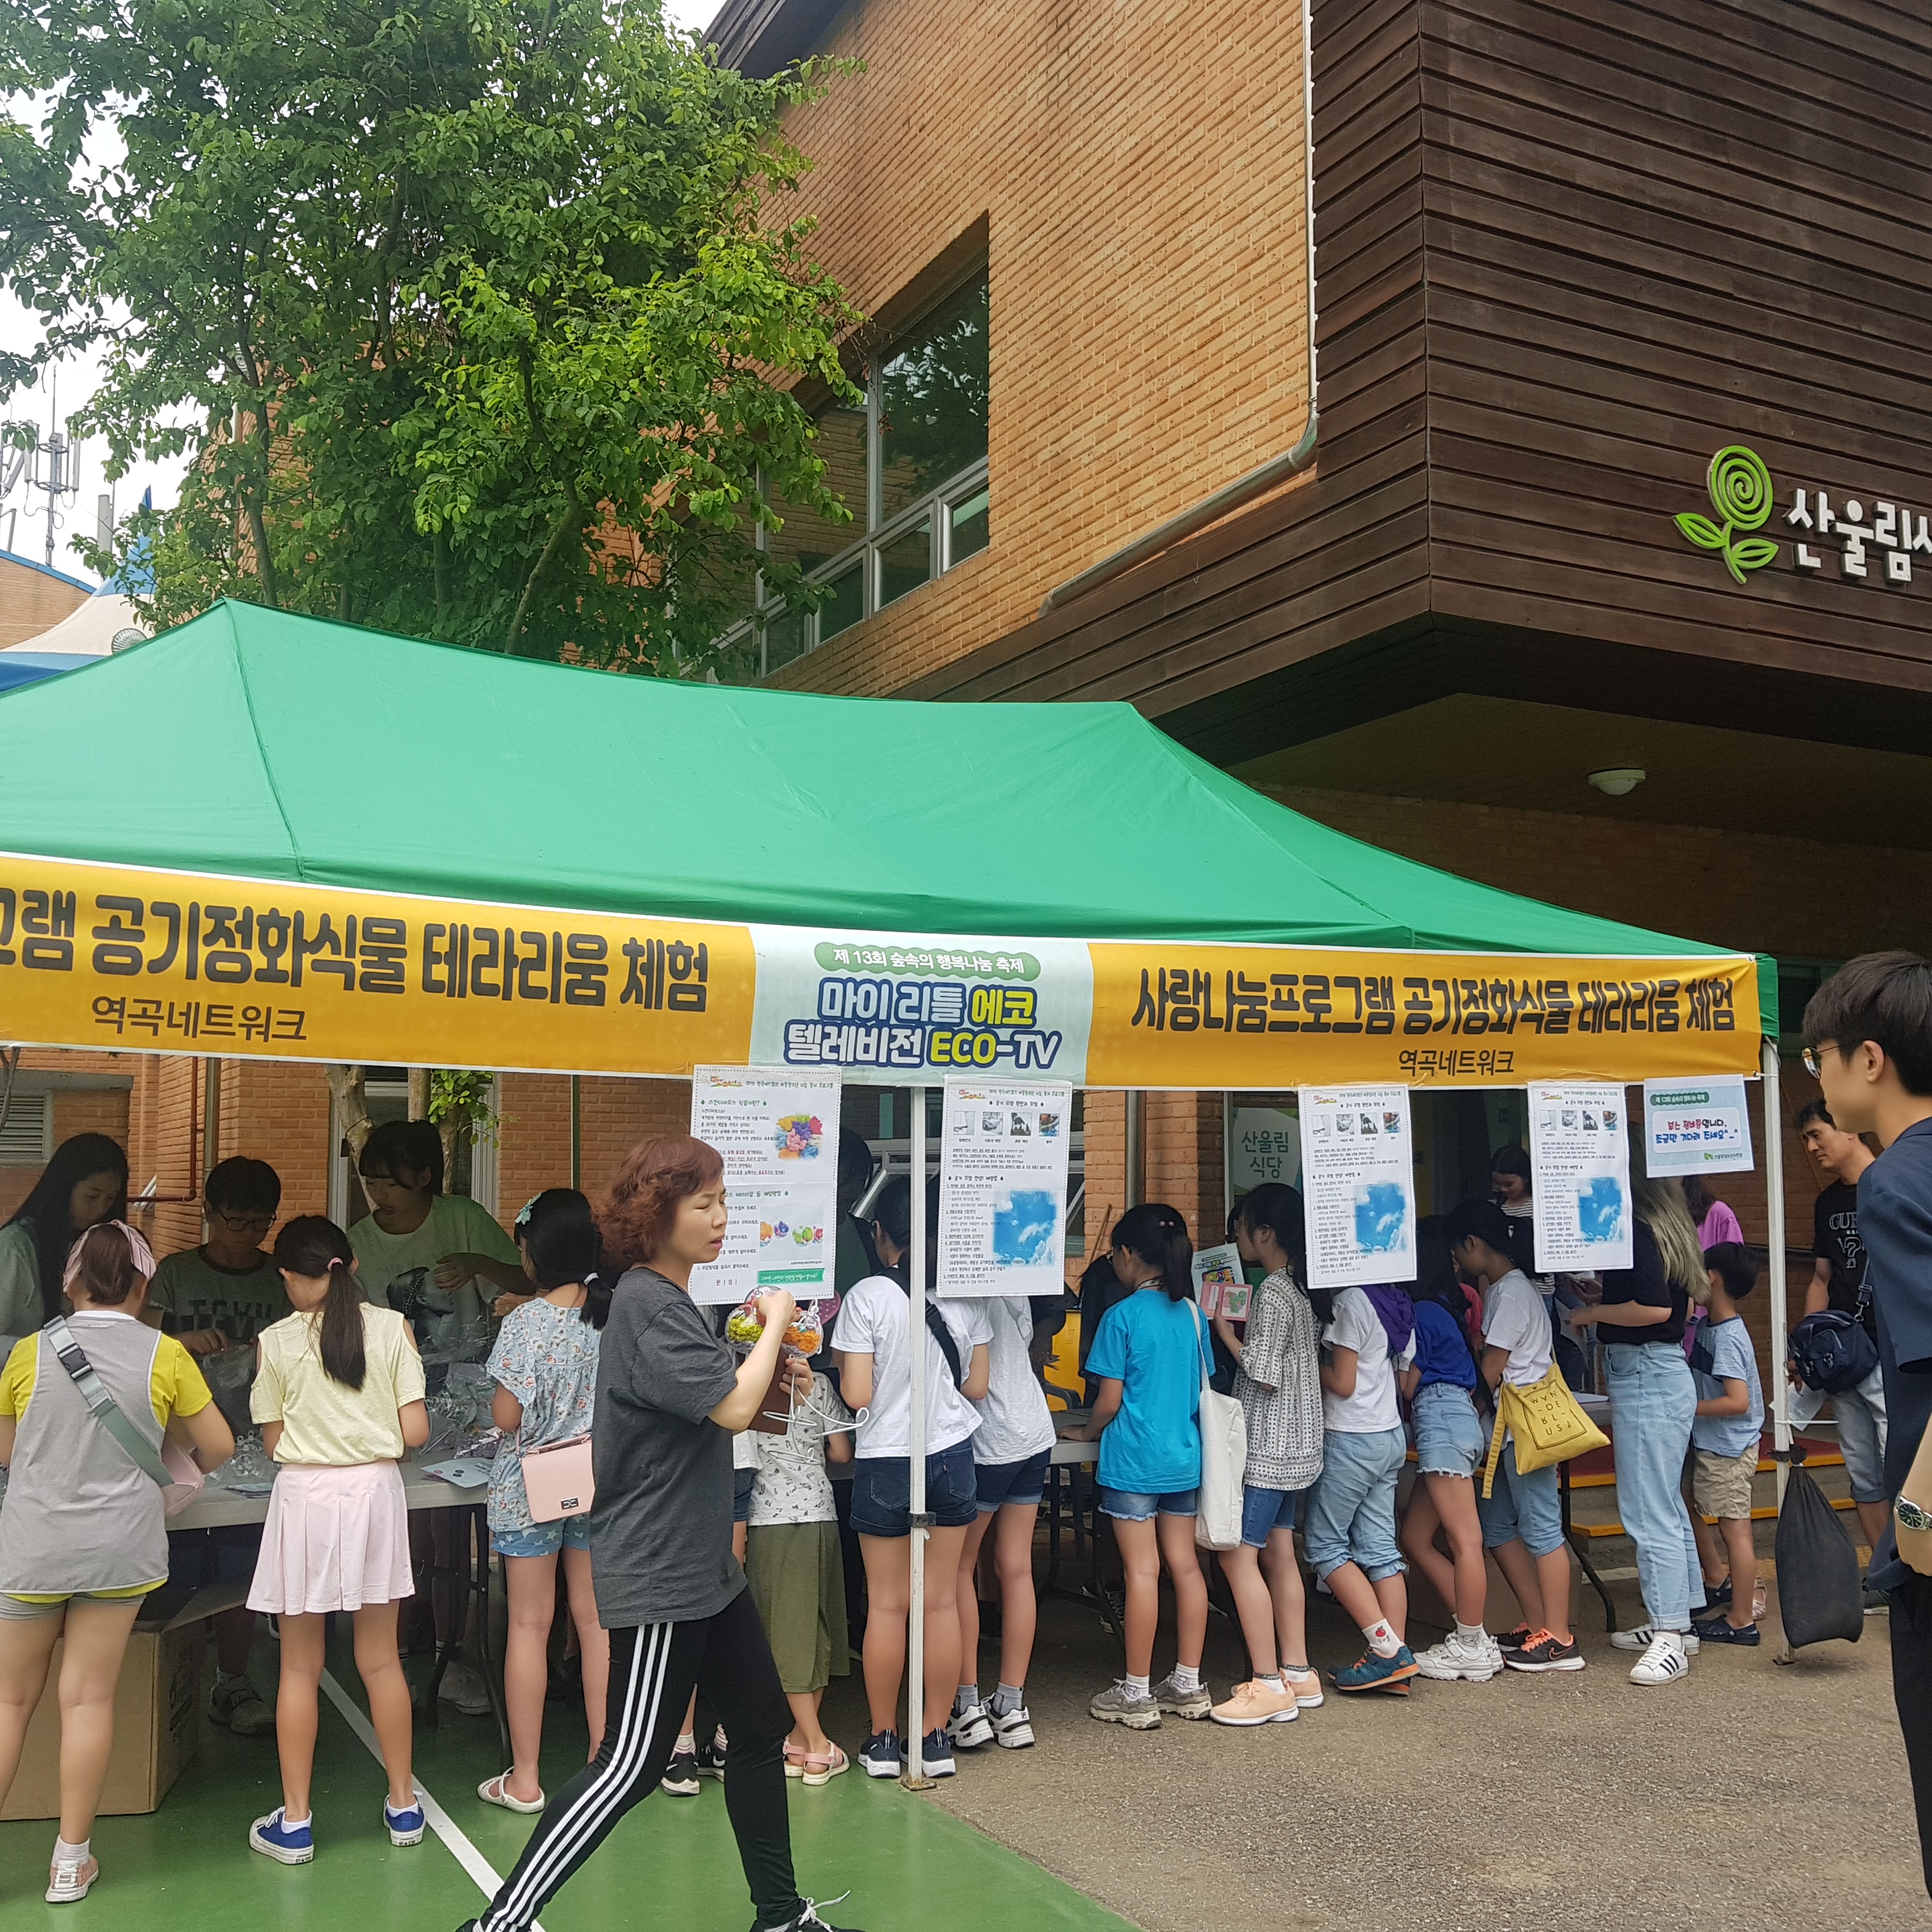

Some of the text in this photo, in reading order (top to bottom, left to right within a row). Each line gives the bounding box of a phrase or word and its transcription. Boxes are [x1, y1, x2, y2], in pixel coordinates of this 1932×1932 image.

[91, 894, 408, 994] 공기정화식물
[422, 922, 609, 1007] 테라리움
[619, 937, 709, 1012] 체험
[833, 948, 1025, 974] 제 13회 숲속의 행복나눔 축제
[821, 979, 1035, 1026] 마이 리틀 에코
[1130, 967, 1736, 1035] 사랑나눔프로그램 공기정화식물 테라리움 체험
[91, 996, 307, 1043] 역곡네트워크
[786, 1022, 1061, 1066] 텔레비전 ECO-TV
[1397, 1048, 1515, 1078] 역곡네트워크
[1655, 1133, 1677, 1144] 조금만
[1680, 1131, 1701, 1142] 기다려
[1667, 1120, 1680, 1130] 부스
[1241, 1130, 1289, 1154] 산울림
[1250, 1156, 1283, 1179] 식당
